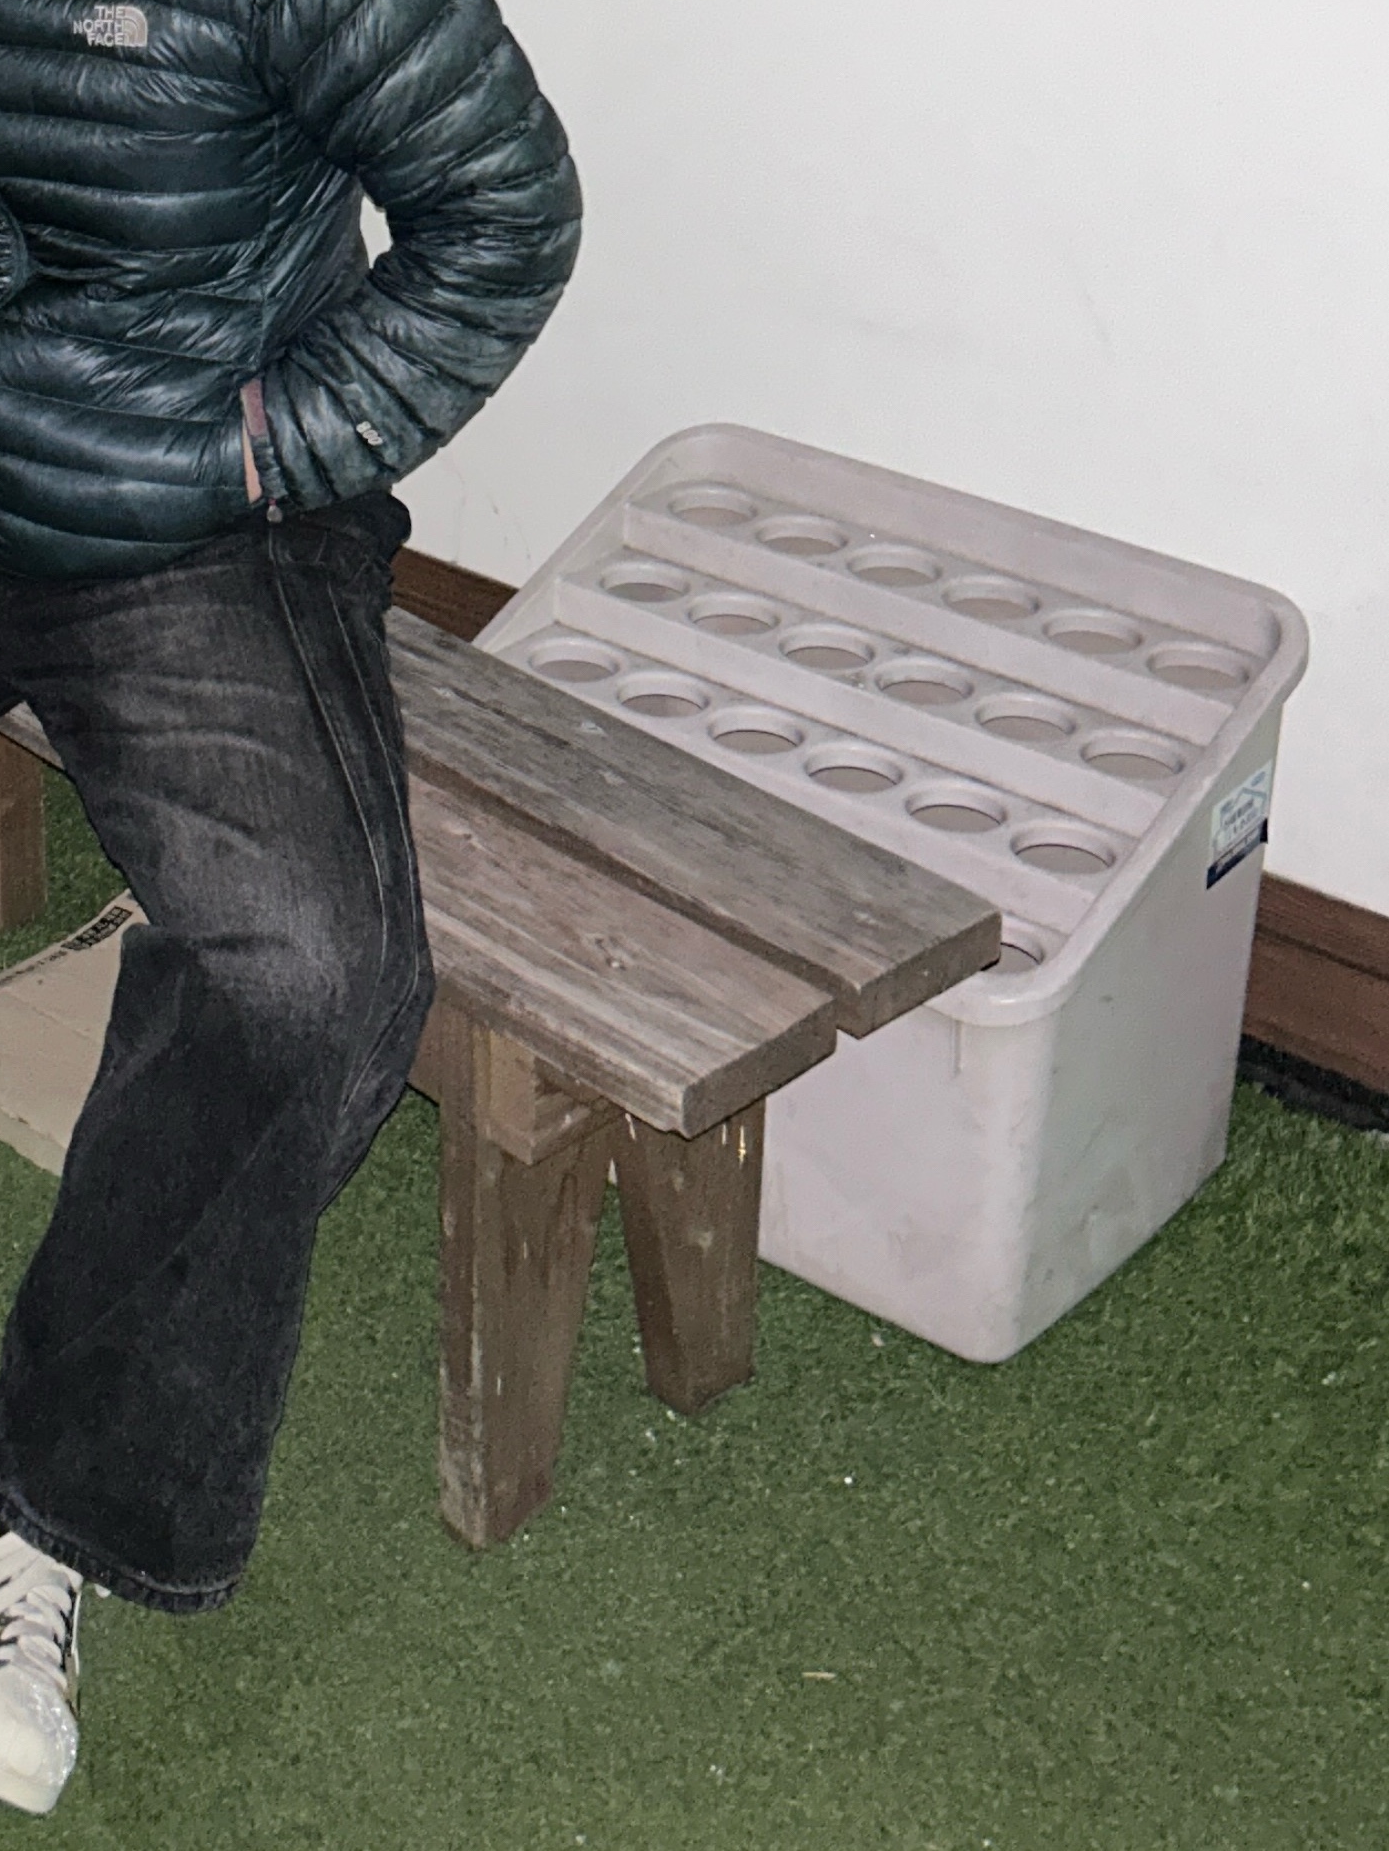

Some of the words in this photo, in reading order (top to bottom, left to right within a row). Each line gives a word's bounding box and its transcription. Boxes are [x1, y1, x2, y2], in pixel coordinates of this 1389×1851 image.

[94, 5, 125, 19] THE
[73, 19, 123, 34] NORTH
[87, 33, 124, 46] FACE
